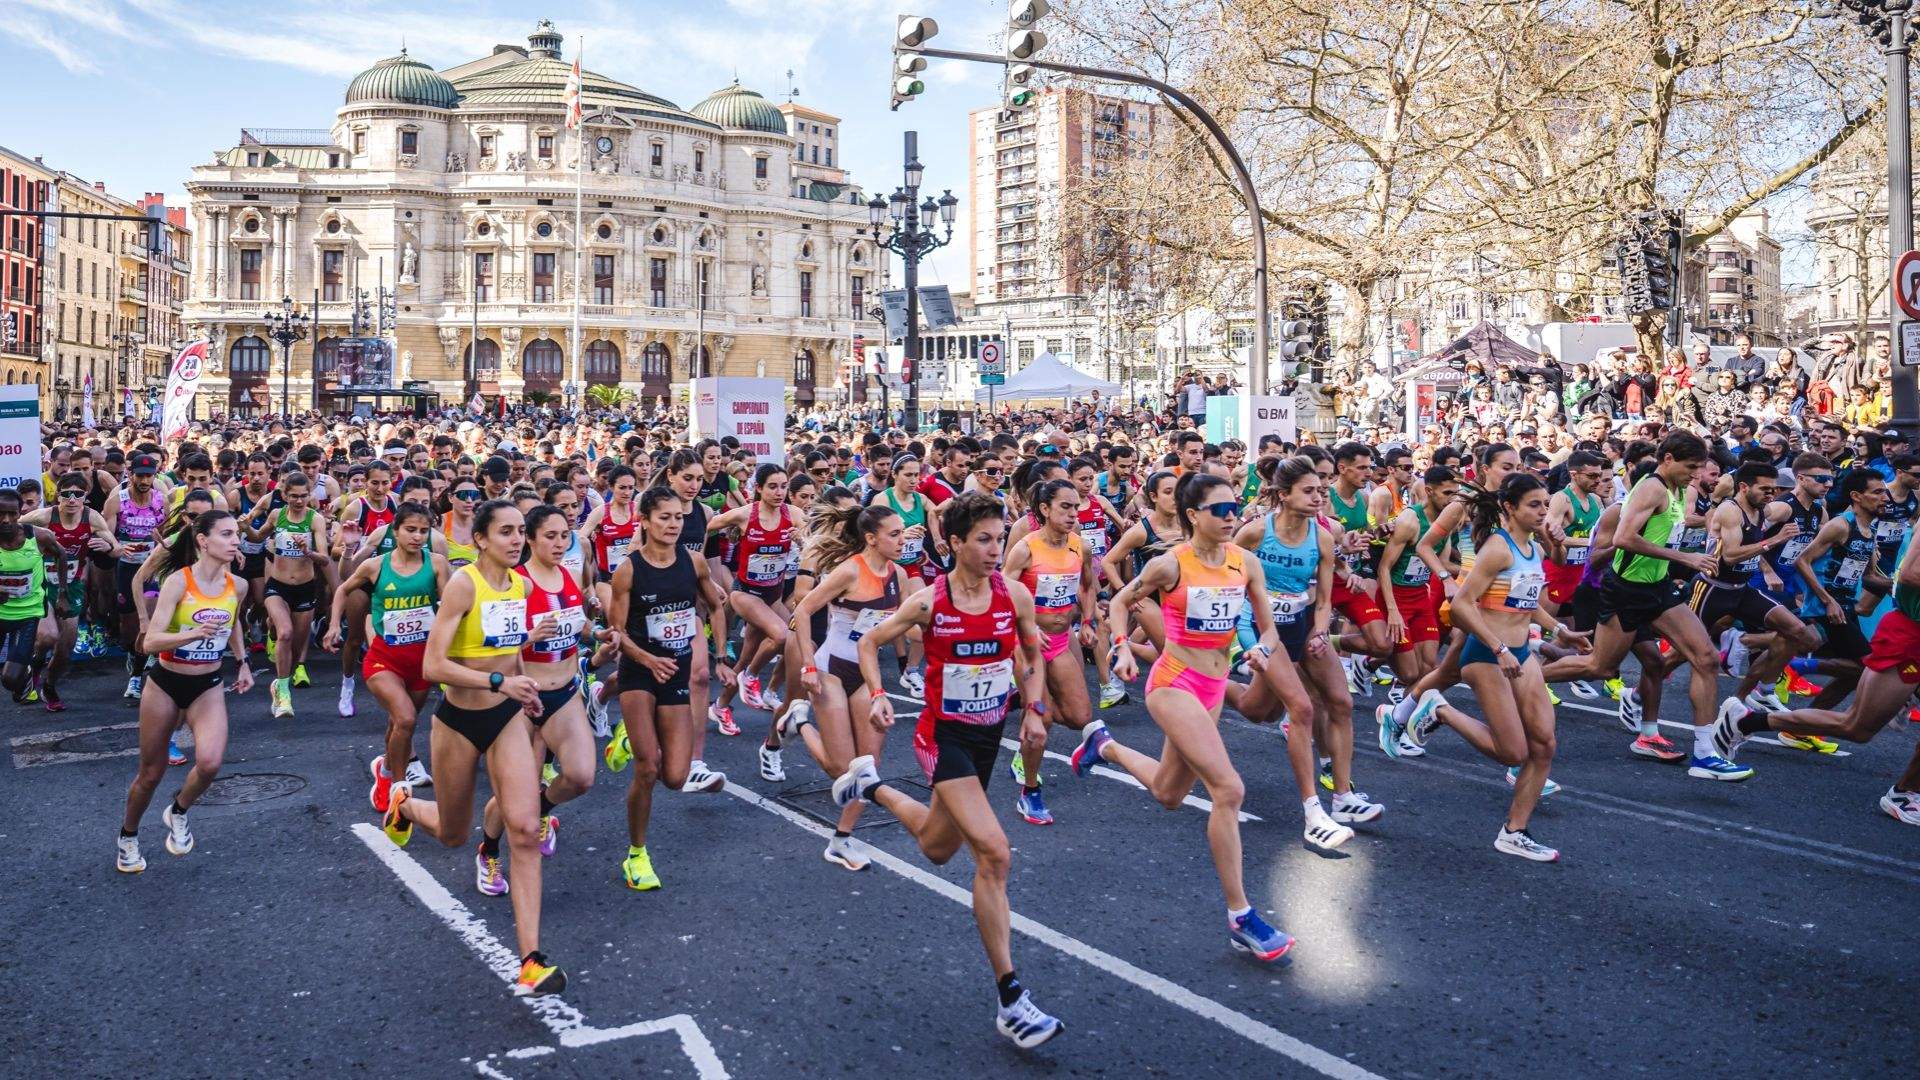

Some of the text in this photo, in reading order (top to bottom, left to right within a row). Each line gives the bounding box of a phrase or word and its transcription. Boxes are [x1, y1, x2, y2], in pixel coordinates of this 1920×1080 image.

[1269, 409, 1287, 420] BM
[763, 564, 776, 573] 18
[1527, 586, 1538, 599] 48
[385, 595, 431, 609] BIKILA
[650, 601, 690, 614] OYSHO
[1045, 597, 1071, 607] Joma
[1211, 603, 1229, 617] 51
[397, 621, 423, 635] 852
[504, 616, 519, 633] 36
[1200, 619, 1234, 630] Joma
[663, 624, 689, 639] 857
[196, 638, 215, 650] 26
[394, 632, 426, 645] Joma
[546, 636, 576, 652] Joma
[973, 641, 998, 655] BM
[186, 650, 219, 661] Joma
[971, 681, 993, 698] 17
[958, 697, 1000, 713] Joma
